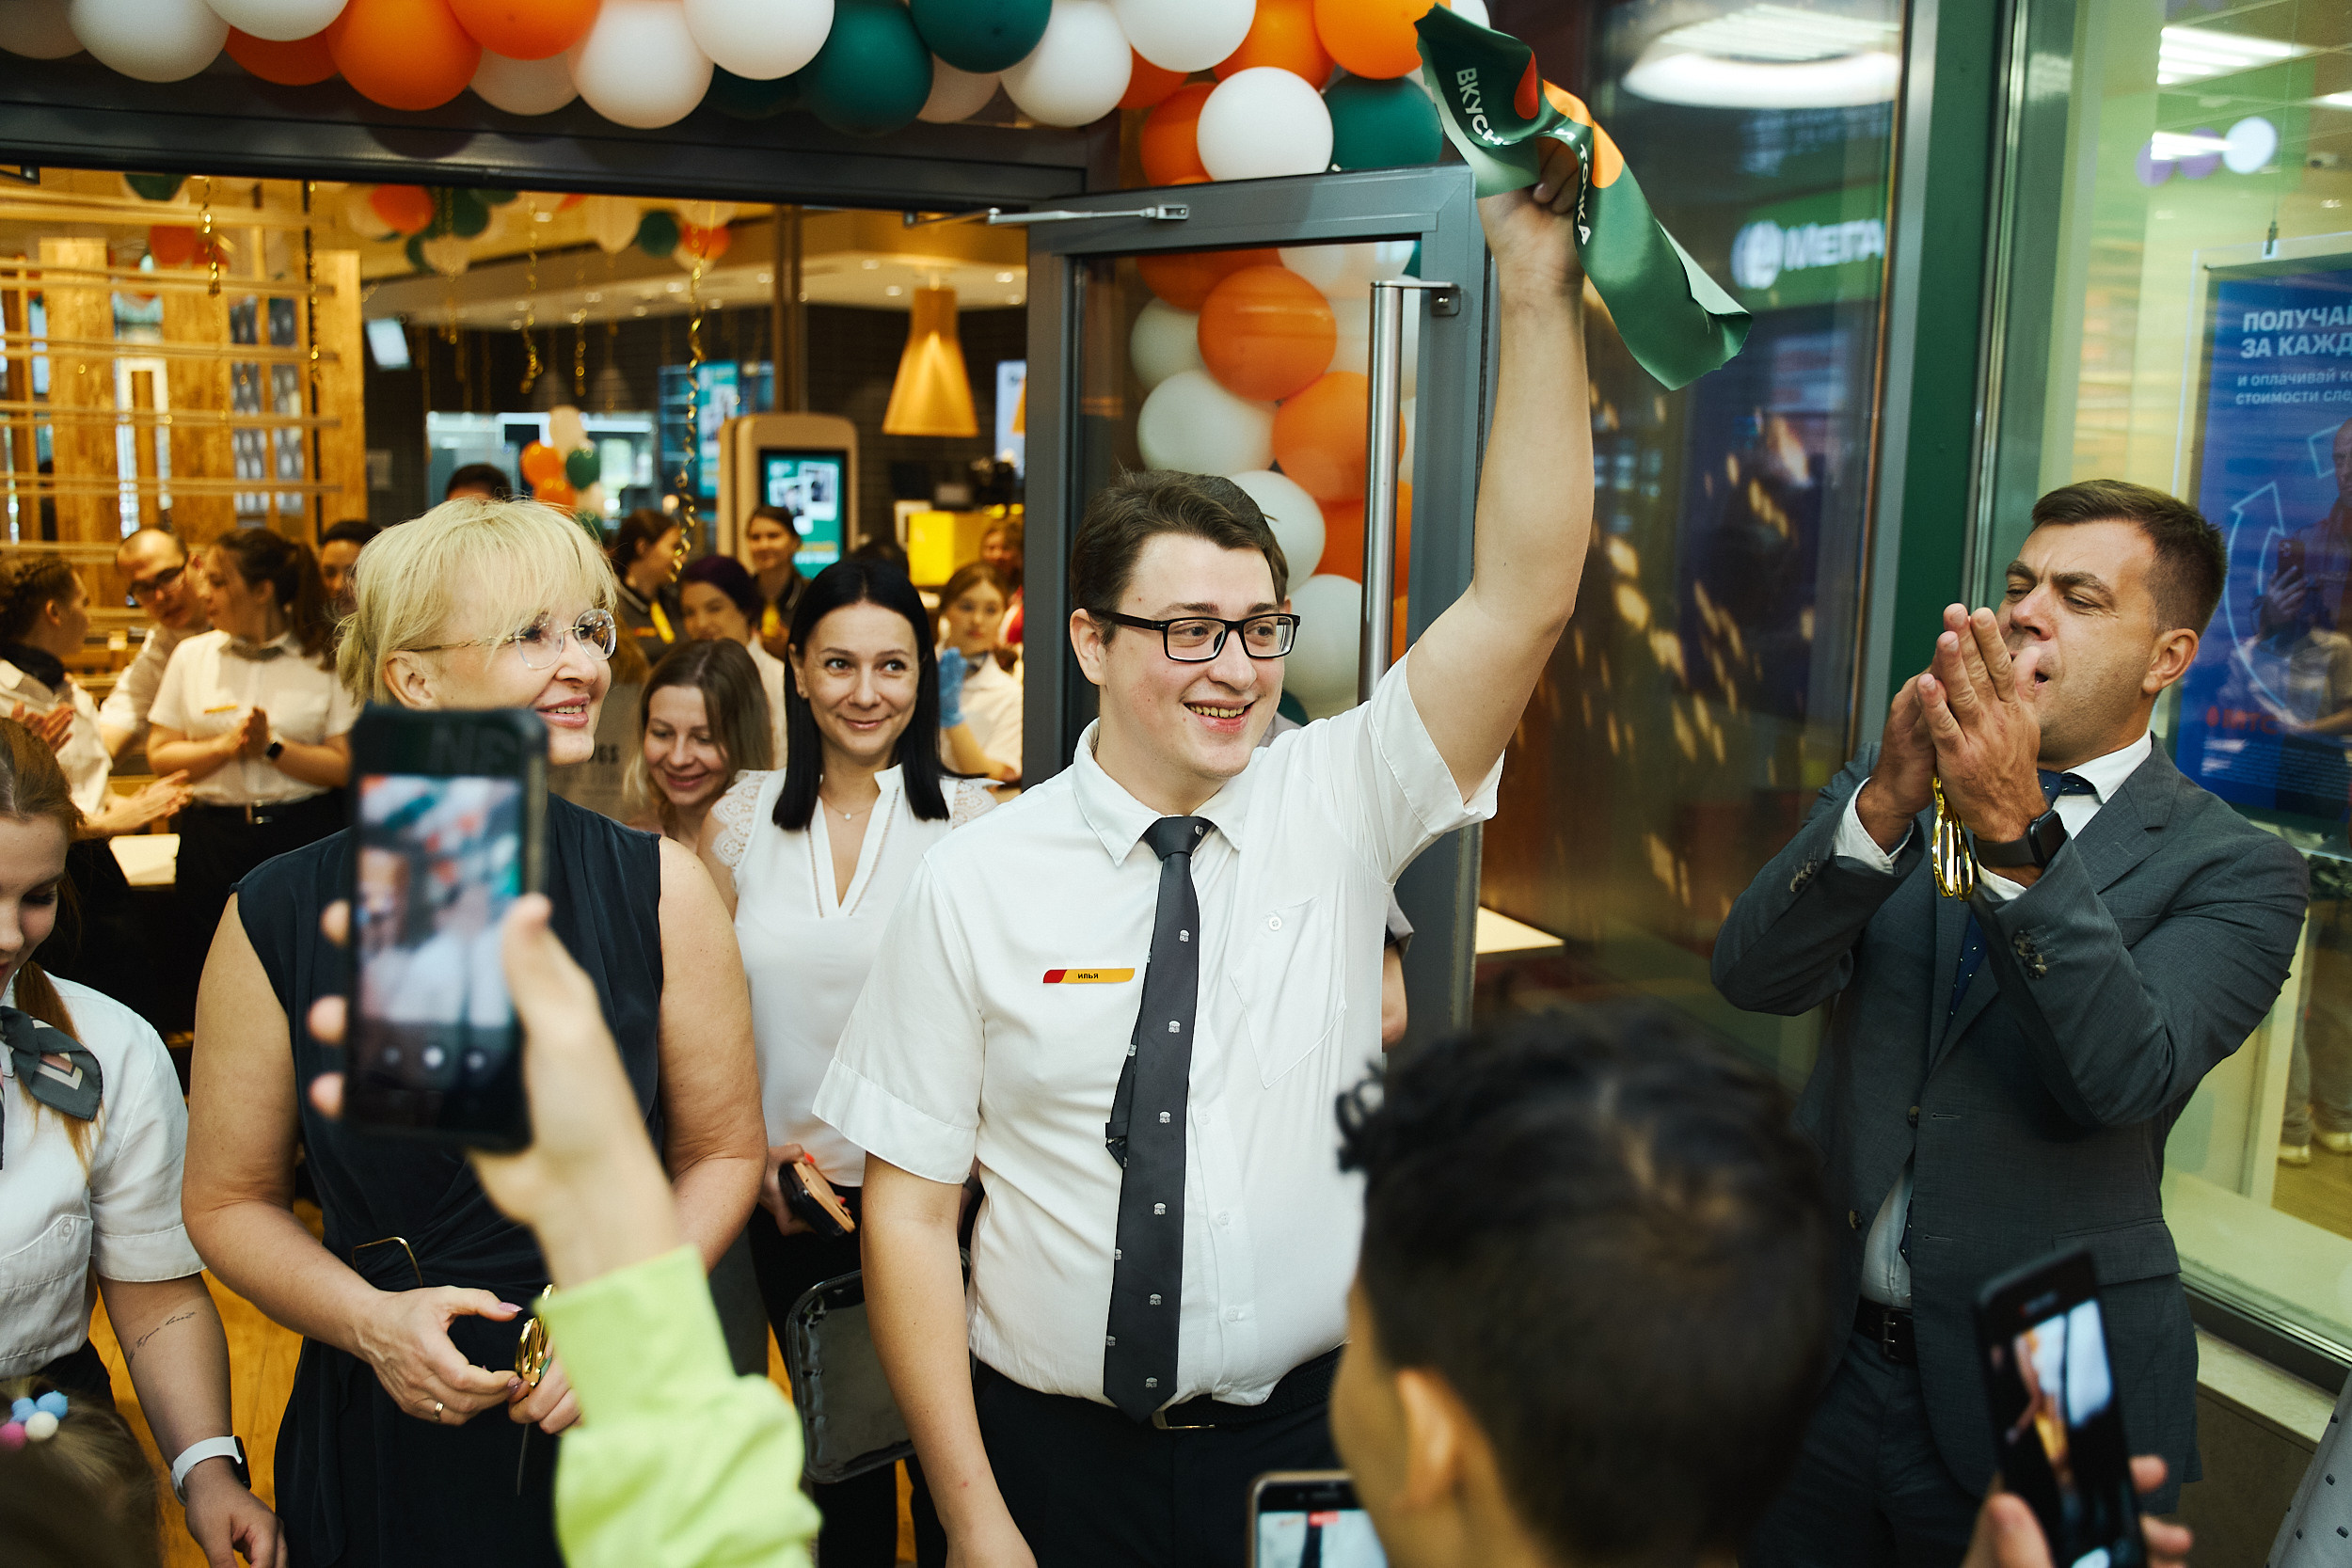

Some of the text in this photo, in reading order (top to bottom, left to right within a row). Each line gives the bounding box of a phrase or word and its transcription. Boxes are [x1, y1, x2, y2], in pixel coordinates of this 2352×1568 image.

[1456, 68, 1521, 146] ВКУСН
[2240, 337, 2272, 358] ЗА
[2237, 374, 2249, 387] и
[2250, 368, 2336, 387] оплачивай
[2235, 390, 2319, 405] стоимости
